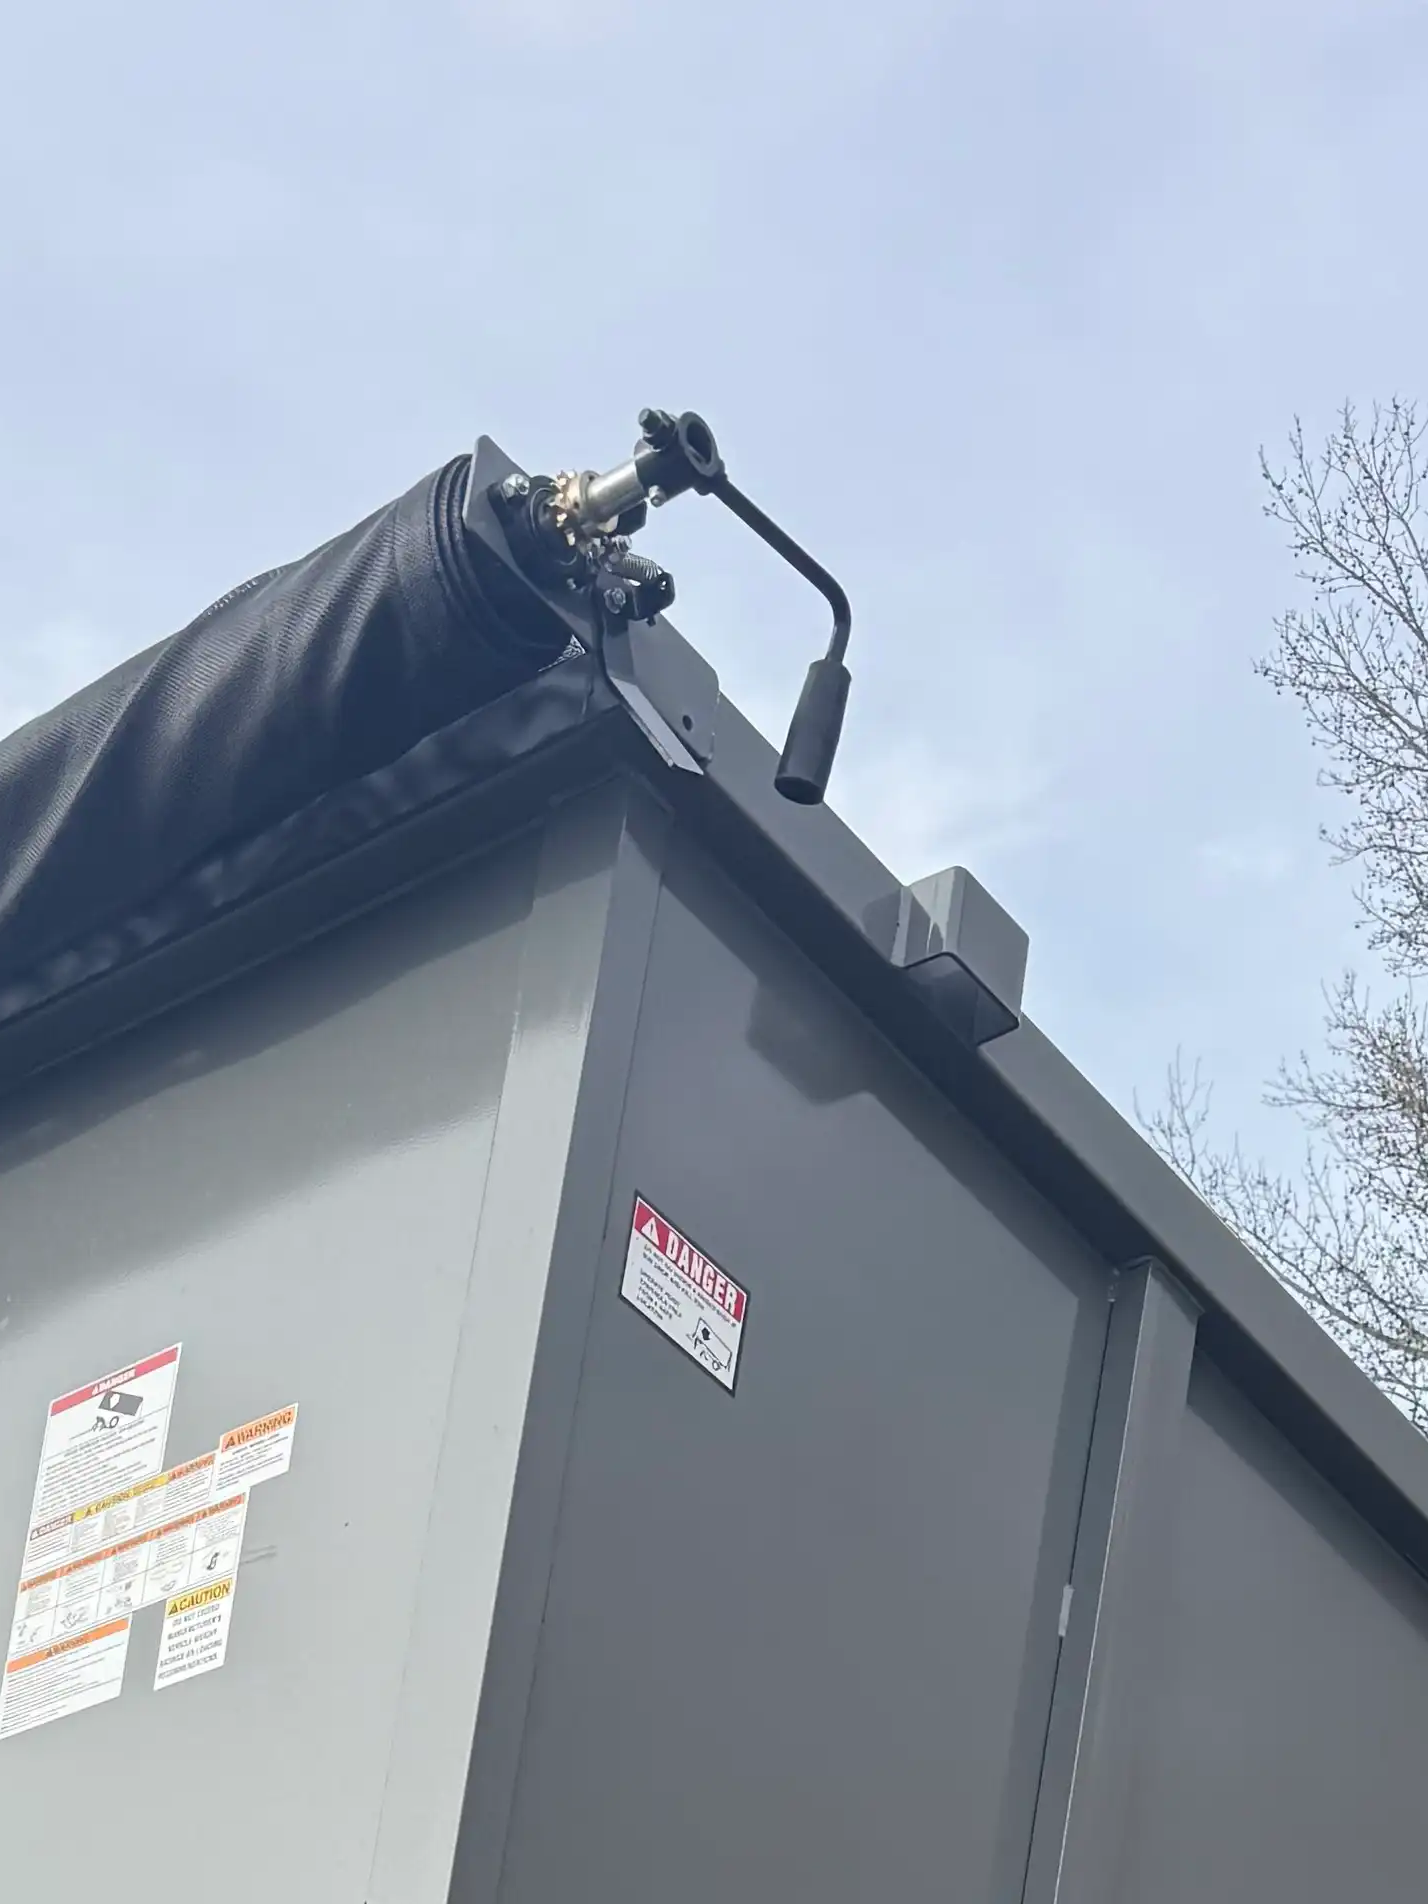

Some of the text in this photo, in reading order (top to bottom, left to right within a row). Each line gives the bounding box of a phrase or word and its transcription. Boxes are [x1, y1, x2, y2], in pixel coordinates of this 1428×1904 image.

[665, 1230, 738, 1316] DANGER
[236, 1409, 292, 1445] WARNING
[179, 1580, 230, 1612] CAUTION
